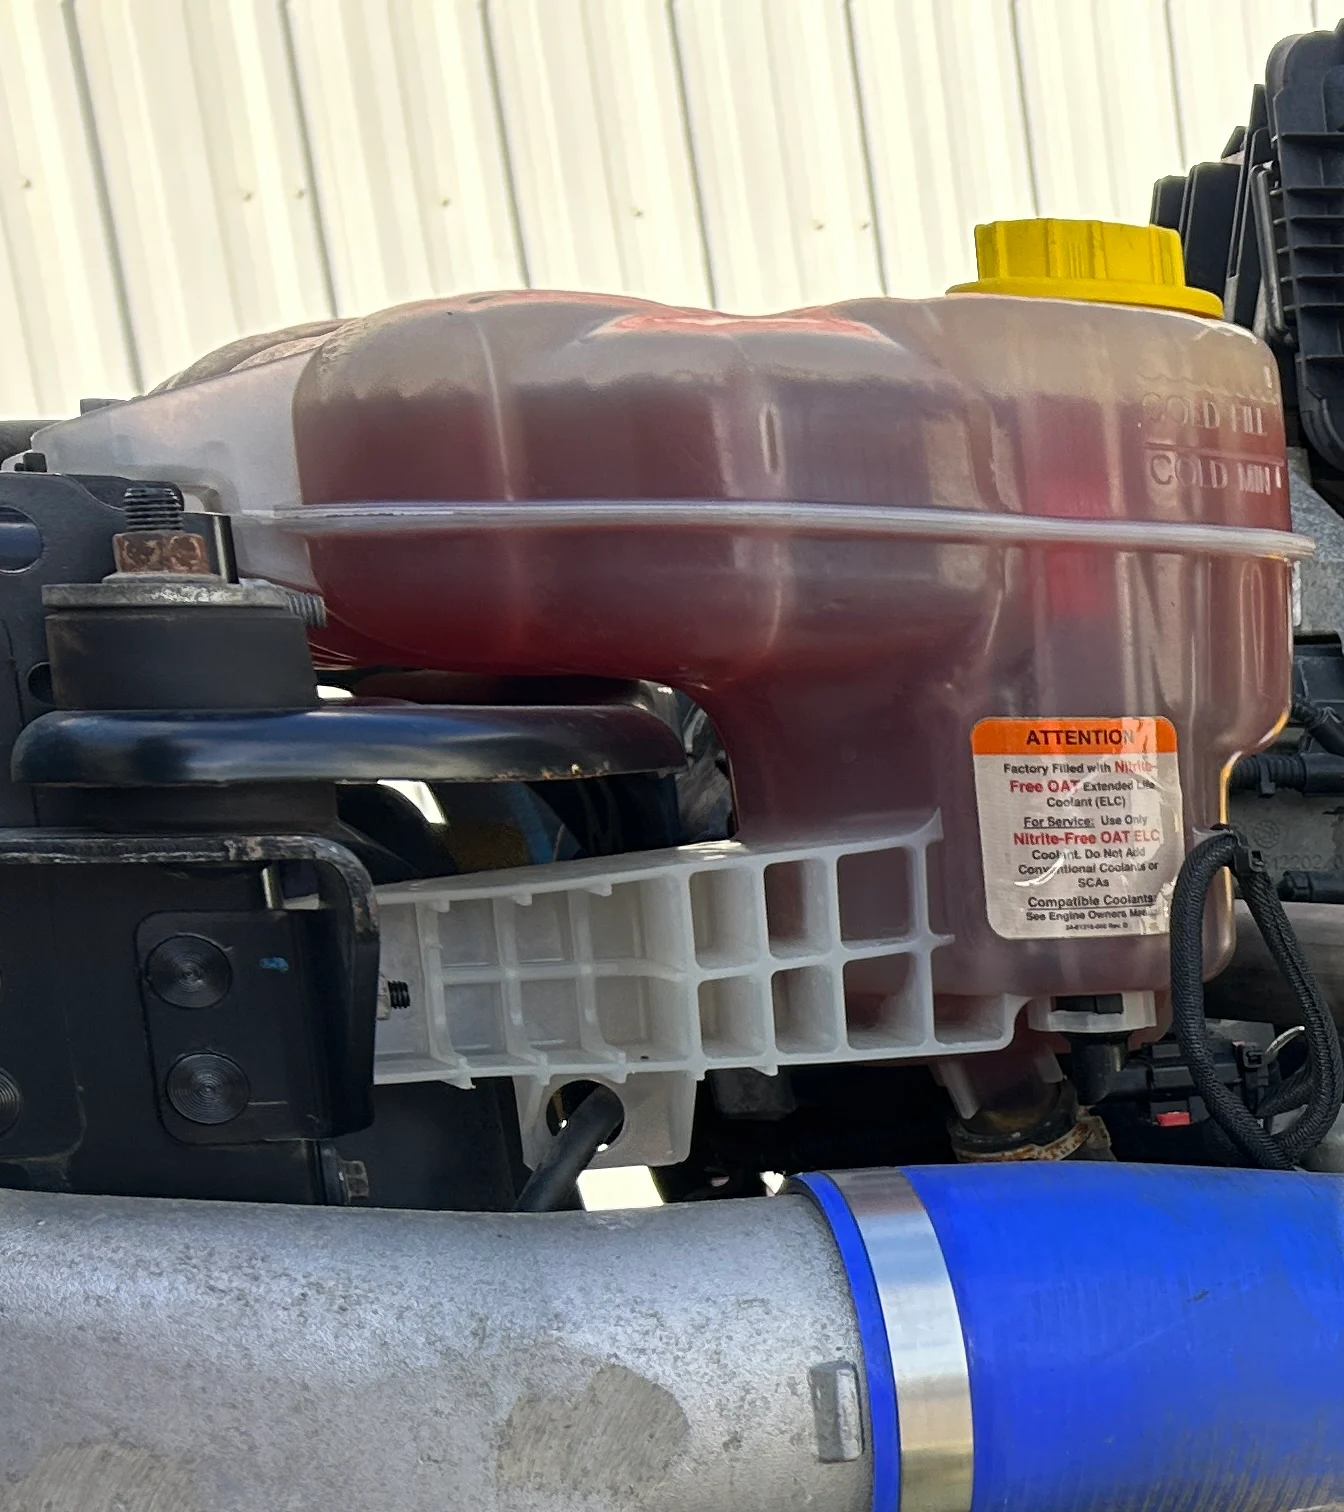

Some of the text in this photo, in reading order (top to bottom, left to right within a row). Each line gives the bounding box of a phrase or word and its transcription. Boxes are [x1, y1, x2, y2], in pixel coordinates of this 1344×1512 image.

[1150, 454, 1228, 488] COLD
[1026, 729, 1135, 745] ATTENTION
[1004, 763, 1049, 776] Factory
[1052, 763, 1084, 774] Filled
[1087, 763, 1112, 773] with
[1009, 780, 1044, 793] Free
[1048, 779, 1080, 792] OAT
[1083, 781, 1133, 791] Extended
[1047, 795, 1127, 809] Coolant (ELC)
[1024, 814, 1148, 828] For Service: Use Only
[1013, 829, 1160, 845] Nitrite-Free OAT ELC
[1085, 849, 1101, 859] Do
[1103, 848, 1123, 859] Not
[1099, 863, 1146, 873] Coolants
[1148, 863, 1158, 871] or
[1078, 877, 1110, 888] SCAs
[1027, 896, 1100, 910] Compatible
[1026, 912, 1046, 921] See
[1049, 911, 1085, 923] Engine
[1088, 910, 1127, 920] Owners
